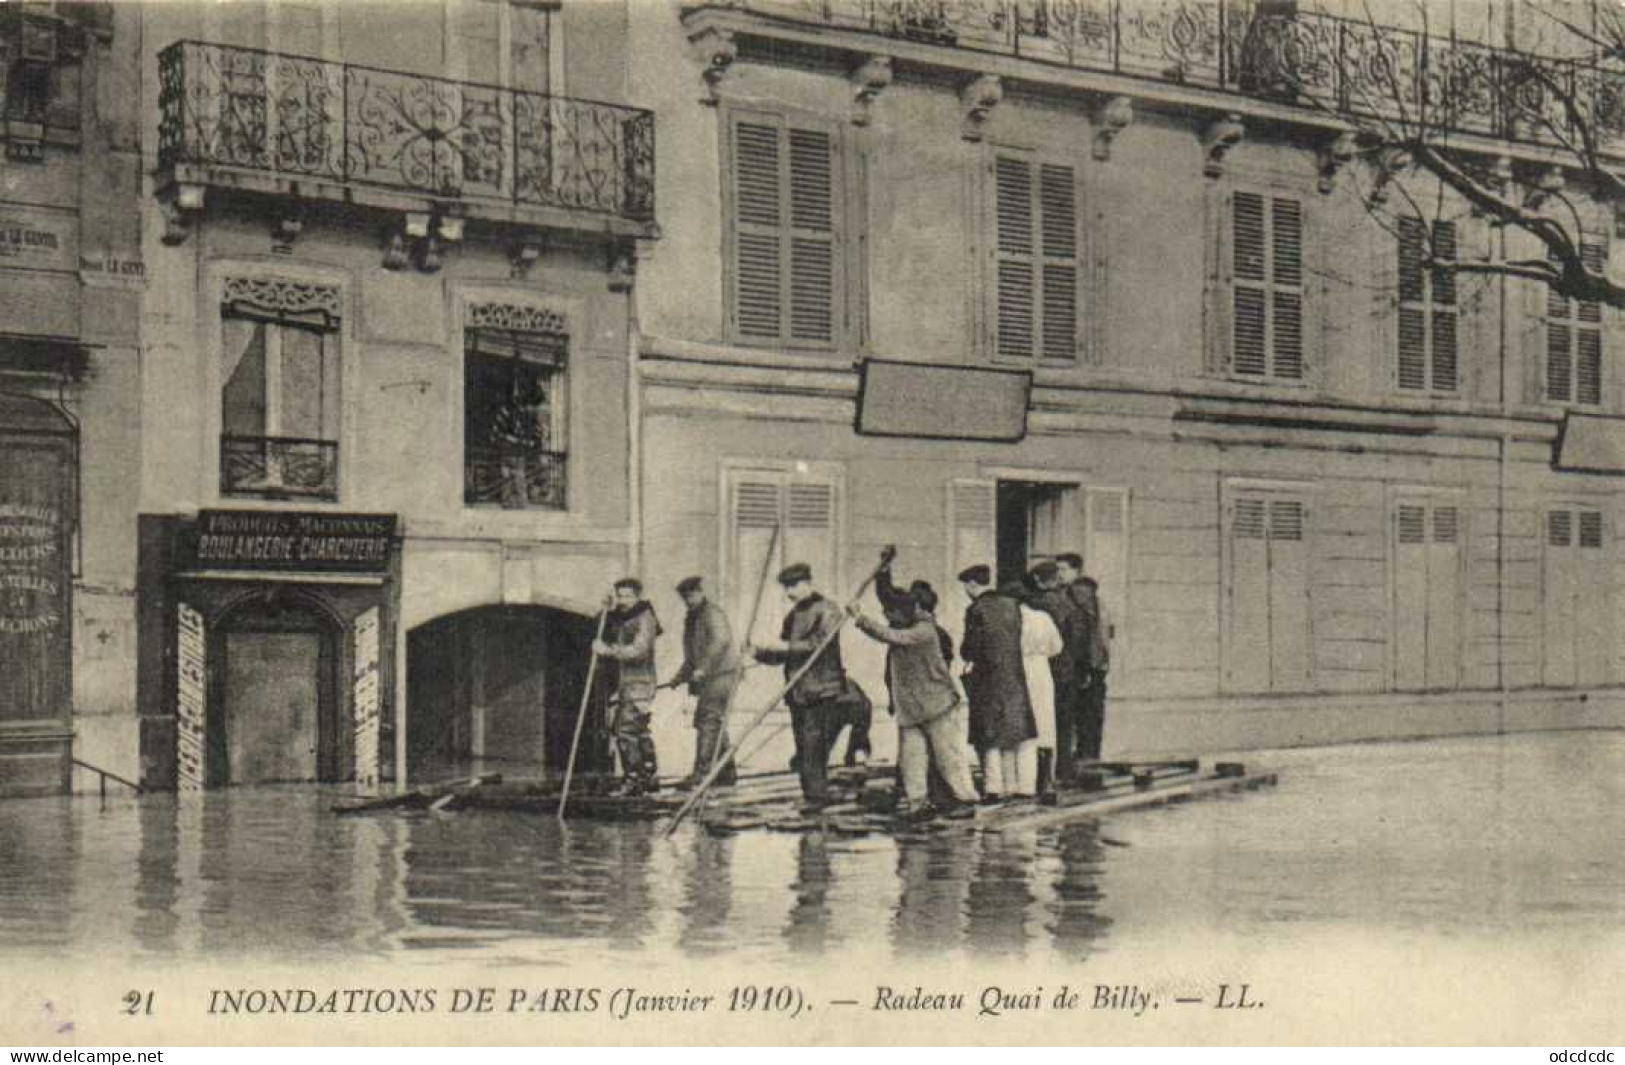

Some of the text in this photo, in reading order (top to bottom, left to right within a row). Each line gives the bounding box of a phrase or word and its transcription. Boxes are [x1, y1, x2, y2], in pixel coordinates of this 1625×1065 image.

[122, 990, 154, 1015] 21
[208, 988, 437, 1013] INONDATIONS
[449, 988, 496, 1012] DE
[507, 988, 602, 1012] PARIS
[609, 988, 714, 1019] (Janvier
[728, 986, 812, 1018] 1910).
[873, 987, 964, 1010] Radeau
[979, 987, 1043, 1016] Quai
[1053, 986, 1079, 1010] de
[1093, 986, 1159, 1017] Billy.
[1214, 985, 1264, 1009] LL.
